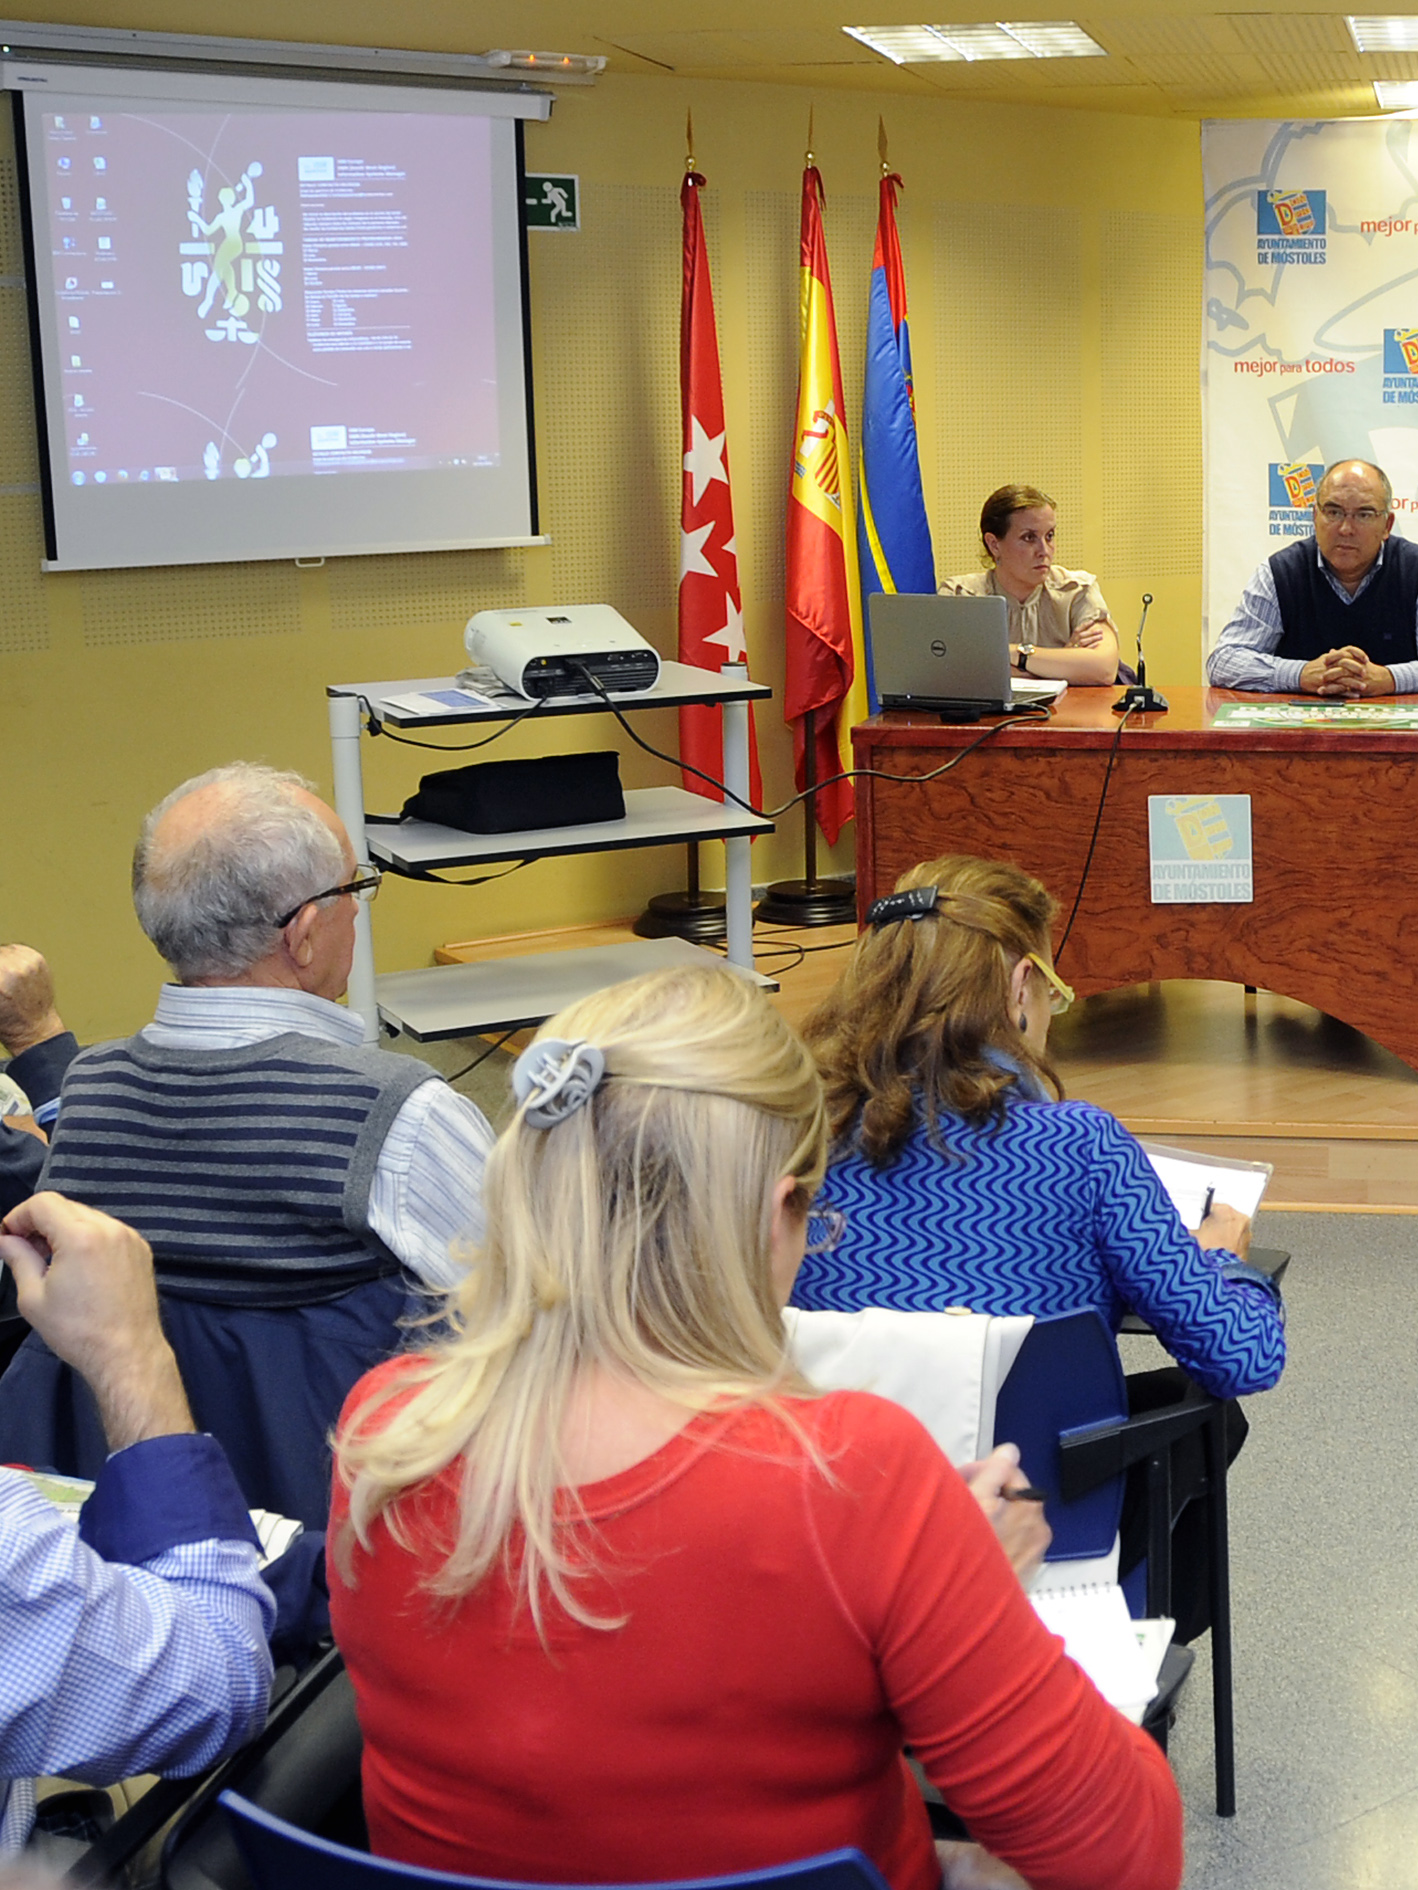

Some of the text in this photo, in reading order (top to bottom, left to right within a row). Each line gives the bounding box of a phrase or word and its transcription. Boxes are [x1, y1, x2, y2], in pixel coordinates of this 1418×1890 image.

[1361, 217, 1412, 237] mejor
[1257, 238, 1326, 250] AYUNTAMIENTO
[1257, 248, 1326, 265] DE MÓSTOLES
[1234, 357, 1355, 377] mejor para todos
[1382, 391, 1396, 404] DE
[1269, 522, 1314, 536] DE MÓSTO
[1152, 864, 1250, 880] AYUNTAMIENTO
[1153, 881, 1251, 900] DE MÓSTOLES
